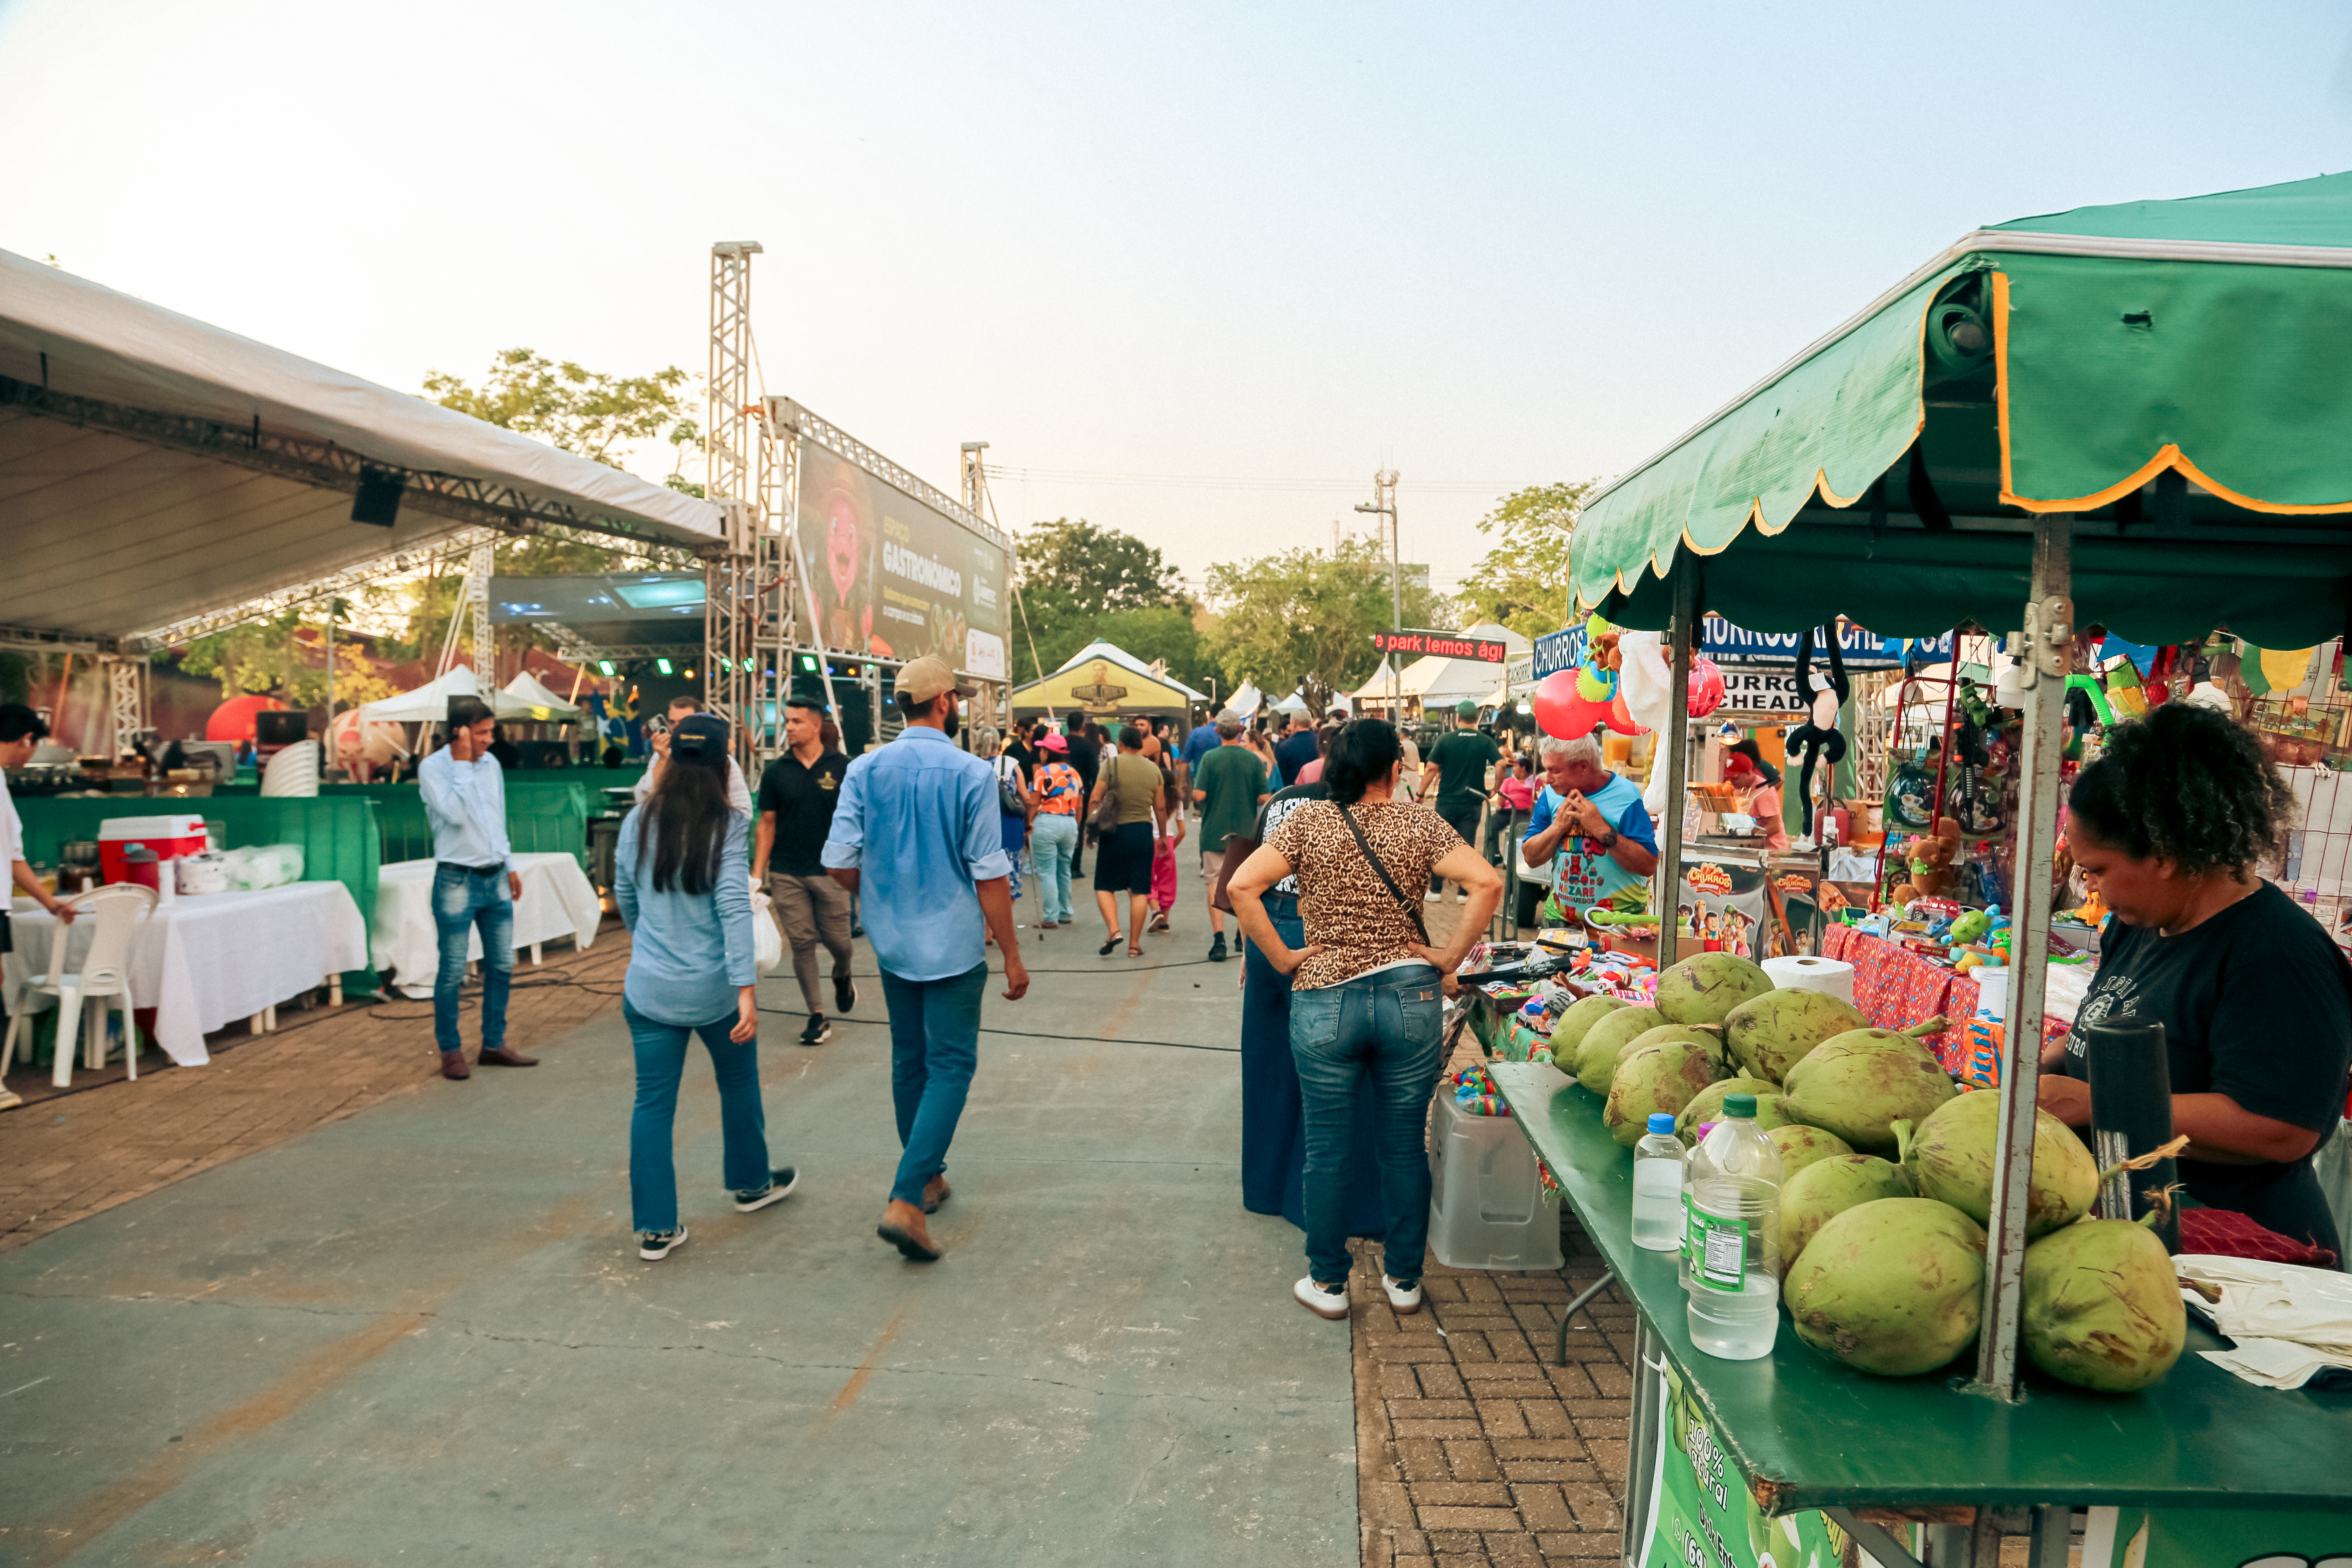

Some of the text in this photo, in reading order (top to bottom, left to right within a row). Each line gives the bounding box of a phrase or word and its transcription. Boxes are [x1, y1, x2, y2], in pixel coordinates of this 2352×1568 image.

[1387, 634, 1423, 652] park
[1690, 870, 1730, 888] CHURROS
[1689, 1418, 1724, 1479] 100%
[1685, 1433, 1728, 1512] Natural
